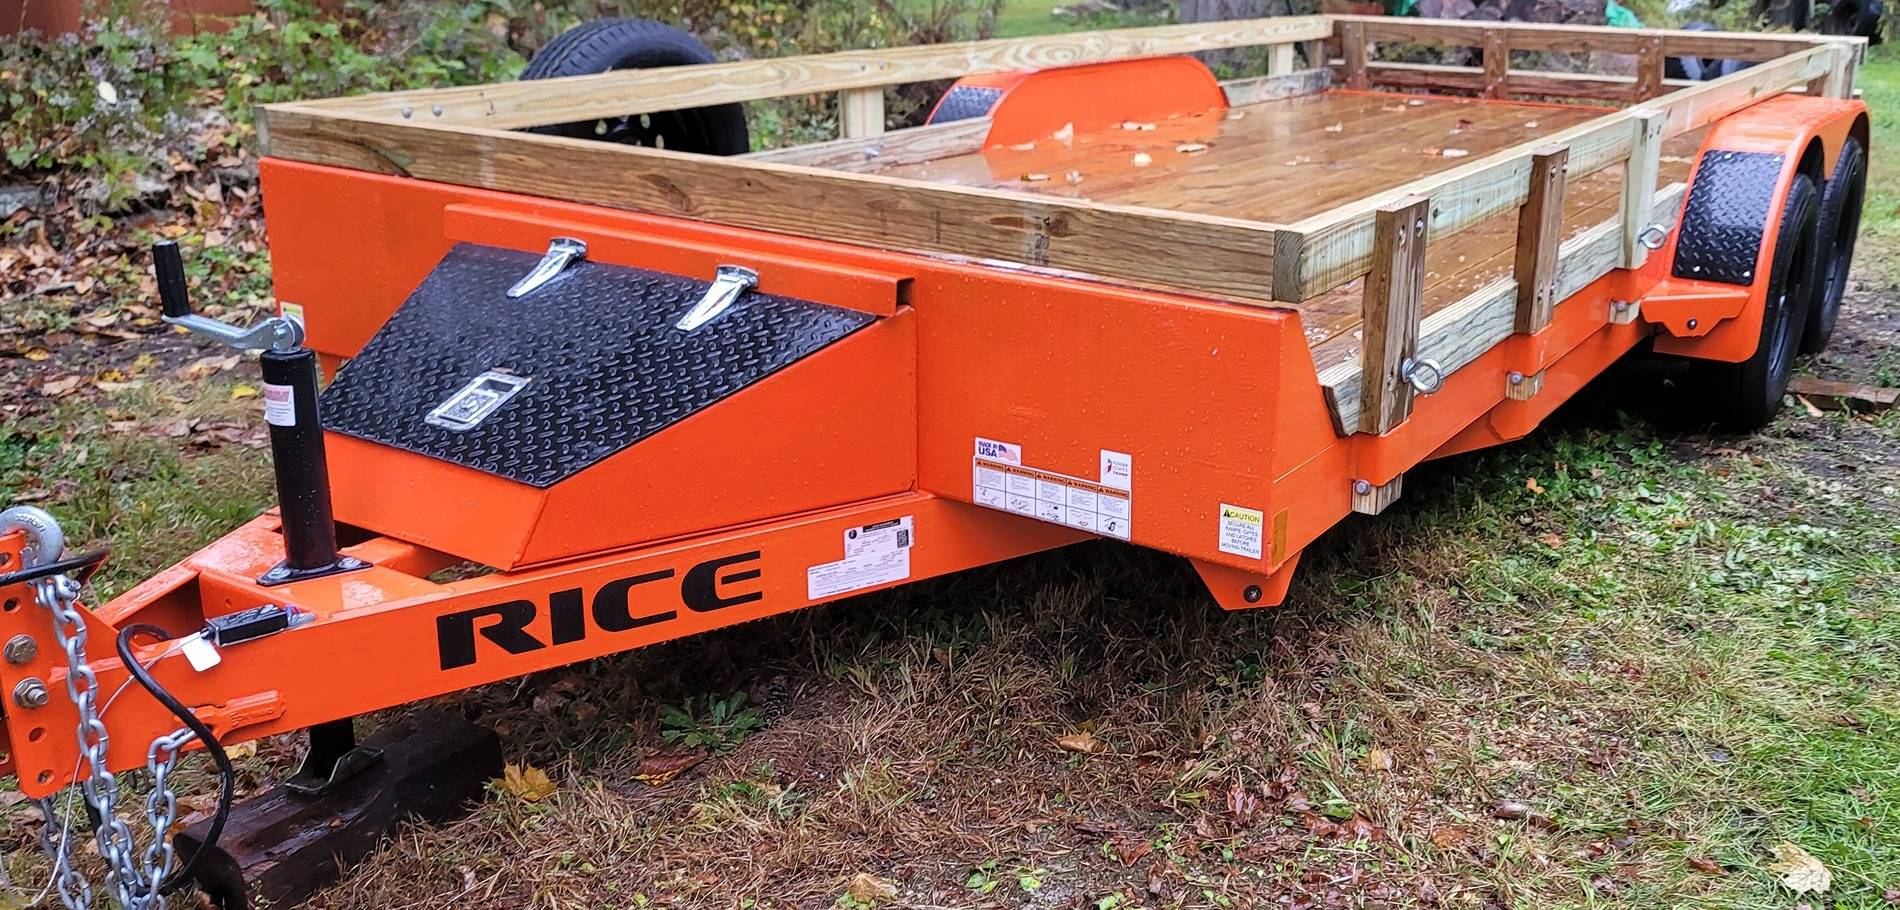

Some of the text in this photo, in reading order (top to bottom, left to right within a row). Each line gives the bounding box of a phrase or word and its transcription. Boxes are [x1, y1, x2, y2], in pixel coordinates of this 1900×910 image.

[978, 440, 992, 448] MADE
[978, 446, 998, 458] USA
[983, 461, 1004, 471] WARNING
[1012, 467, 1035, 477] WARNING
[1043, 475, 1066, 484] WARNING
[1074, 480, 1097, 491] WARNING
[1105, 489, 1128, 497] WARNING
[1230, 511, 1260, 523] CAUTION
[1227, 520, 1245, 528] SECURE
[1244, 529, 1259, 537] GATES
[1221, 541, 1240, 550] MOVING
[1231, 538, 1249, 546] BEFORE
[436, 550, 763, 671] RICE
